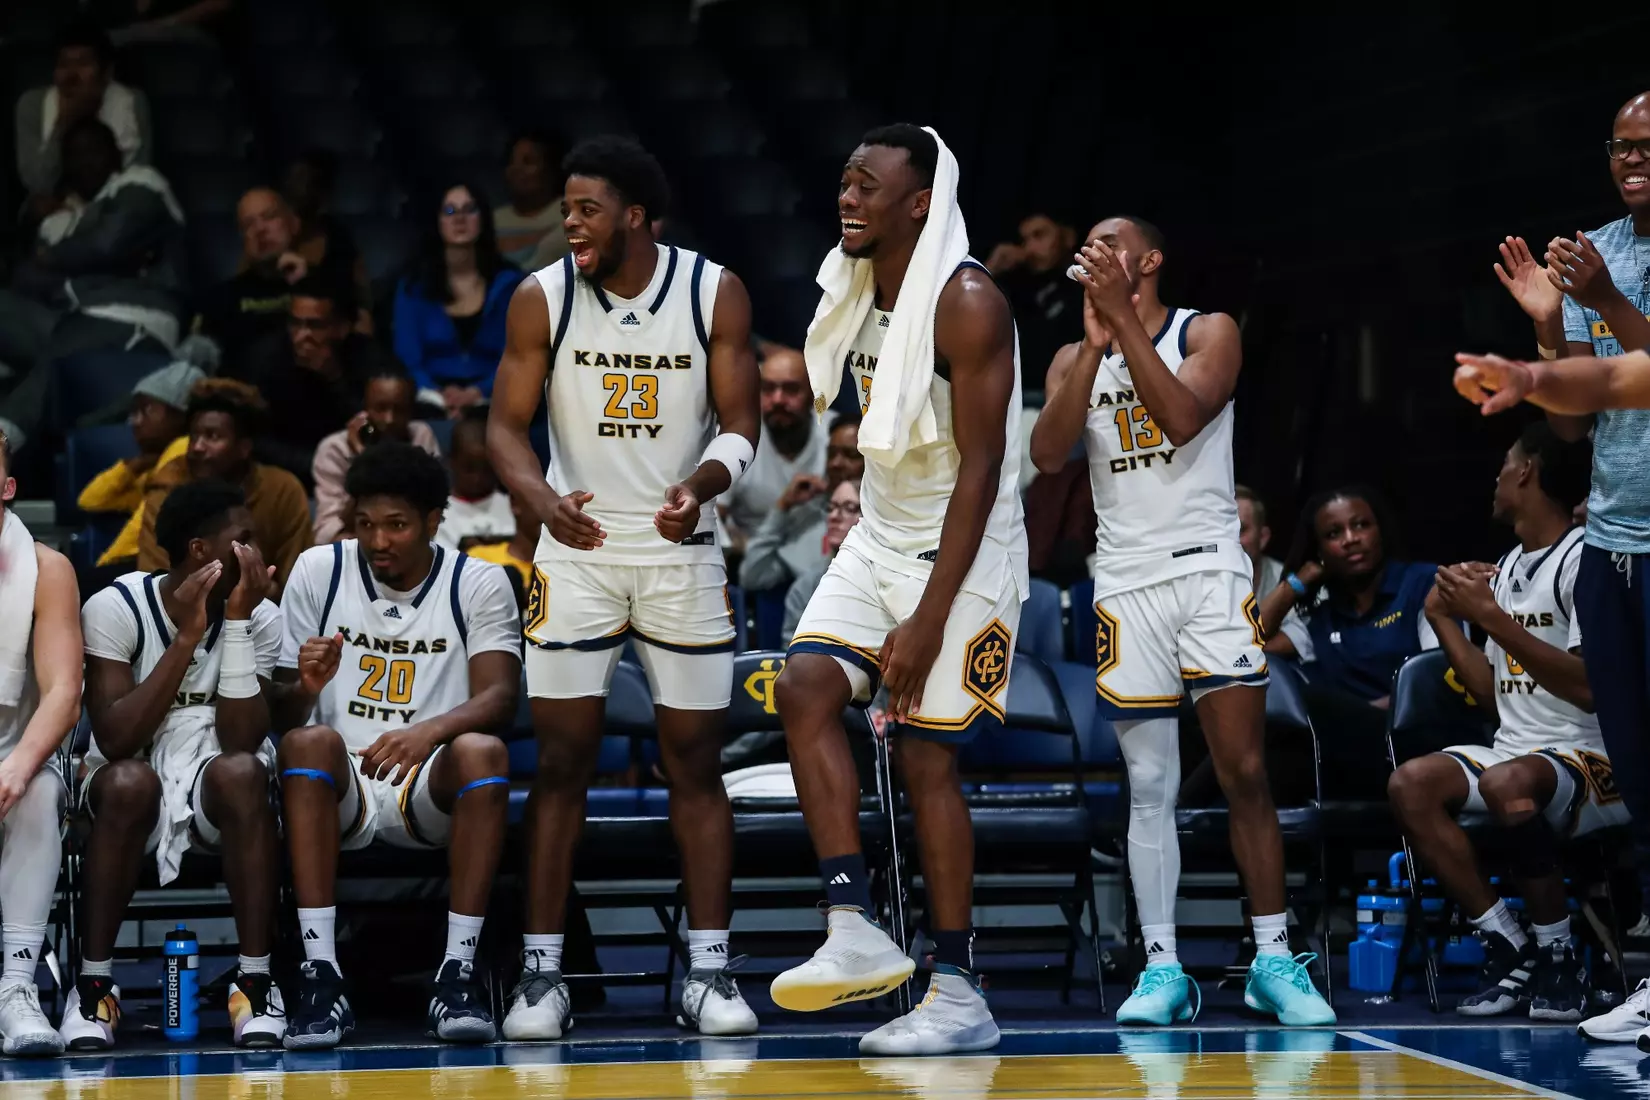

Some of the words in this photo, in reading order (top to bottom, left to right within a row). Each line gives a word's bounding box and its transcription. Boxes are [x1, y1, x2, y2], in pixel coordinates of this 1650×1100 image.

[573, 349, 692, 370] KANSAS
[602, 373, 659, 419] 23
[597, 422, 664, 439] CITY
[1114, 405, 1164, 452] 13
[1109, 448, 1177, 474] CITY
[336, 625, 447, 655] KANSAS
[357, 653, 416, 705] 20
[347, 700, 418, 724] CITY
[168, 957, 178, 1027] POWERADE
